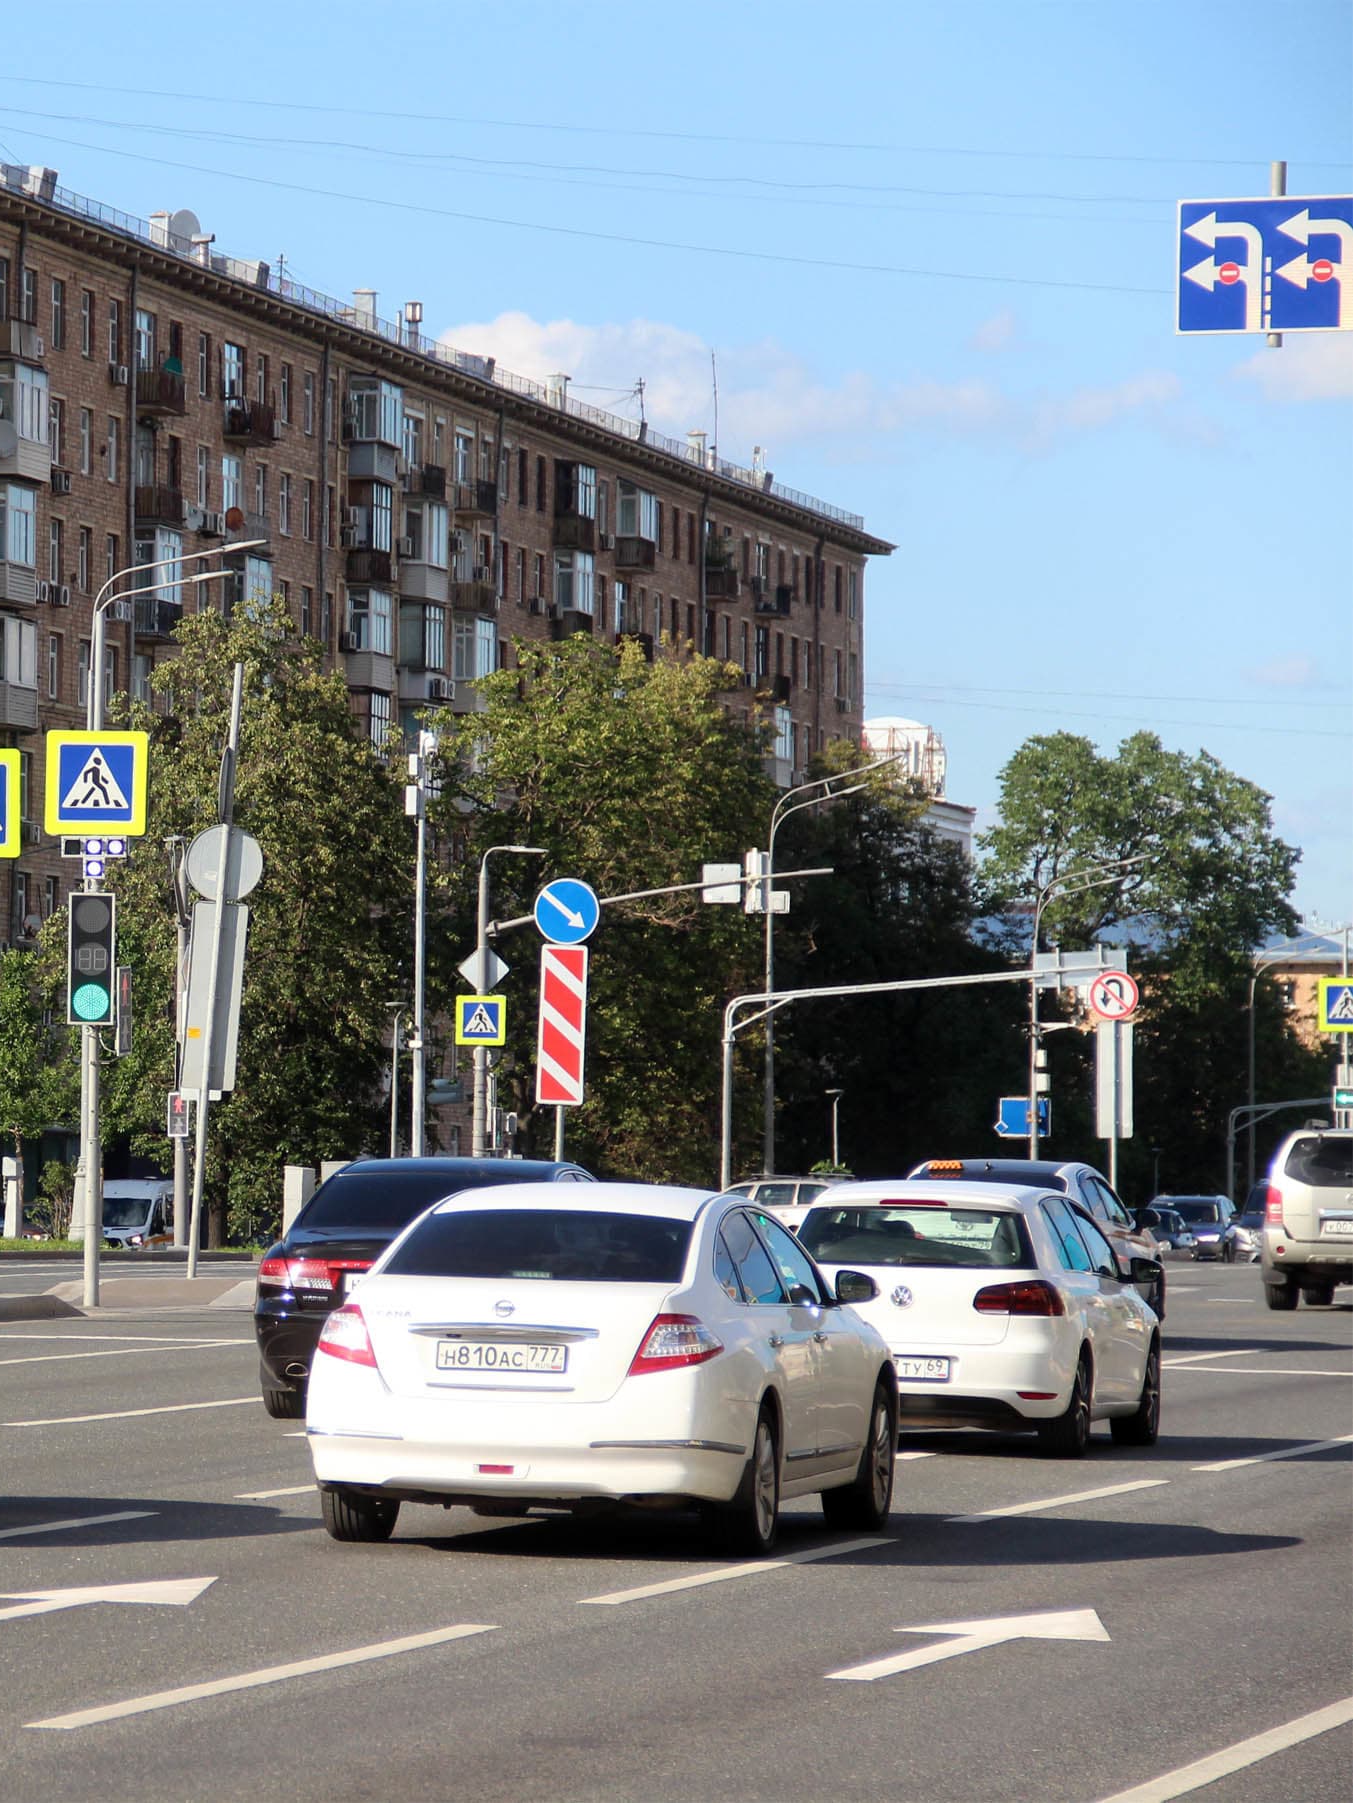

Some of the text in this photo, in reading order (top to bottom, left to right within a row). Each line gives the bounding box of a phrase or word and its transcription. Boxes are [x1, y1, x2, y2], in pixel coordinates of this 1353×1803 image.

[445, 1346, 560, 1367] Н810АС 777
[928, 1359, 943, 1372] 69
